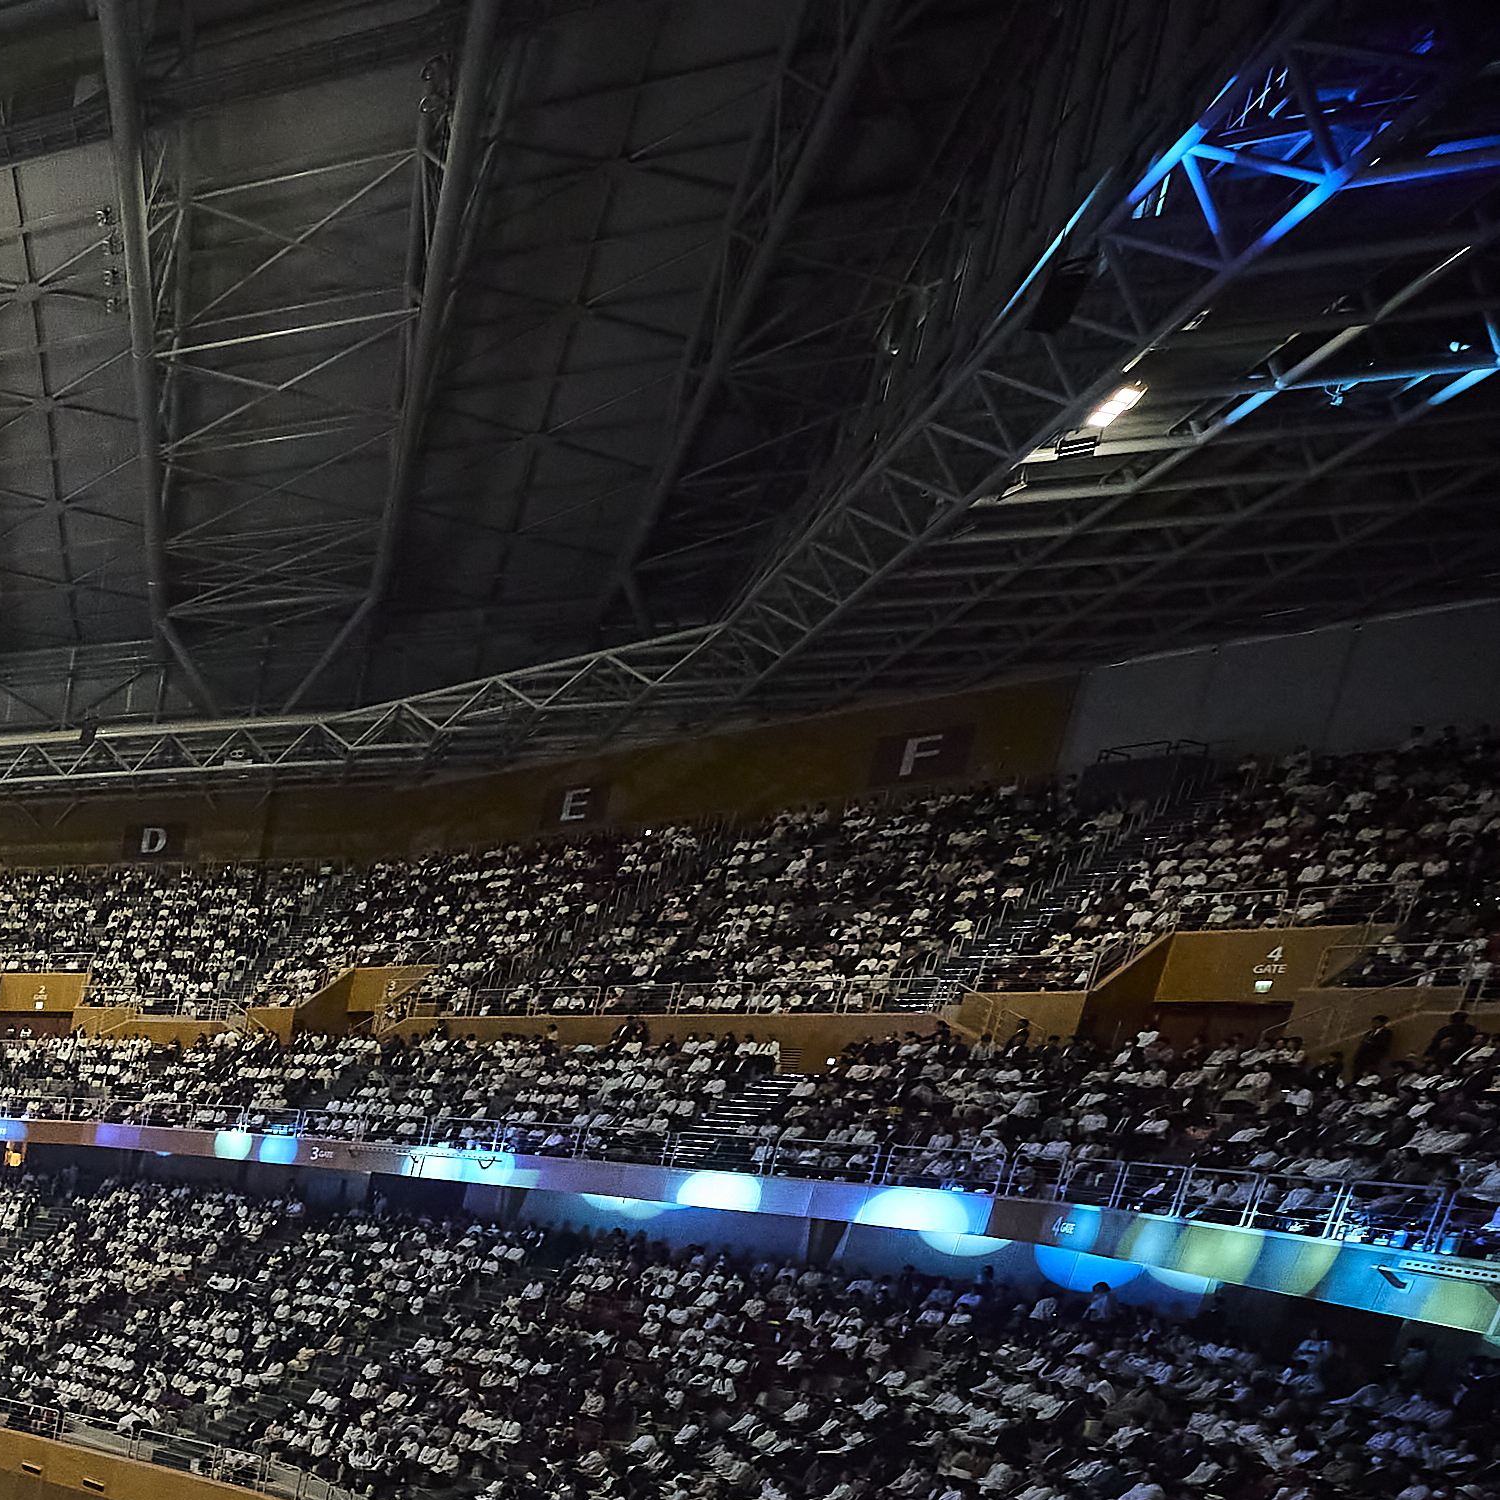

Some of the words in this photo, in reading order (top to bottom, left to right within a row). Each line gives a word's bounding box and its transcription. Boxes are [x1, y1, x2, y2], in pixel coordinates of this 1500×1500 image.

[899, 733, 944, 776] F
[559, 787, 591, 821] E
[141, 826, 167, 854] D
[1267, 946, 1284, 961] 4
[1253, 963, 1288, 974] GATE
[39, 985, 45, 993] 2
[310, 1146, 319, 1160] 3
[319, 1151, 334, 1159] GATE
[1052, 1216, 1063, 1236] 4
